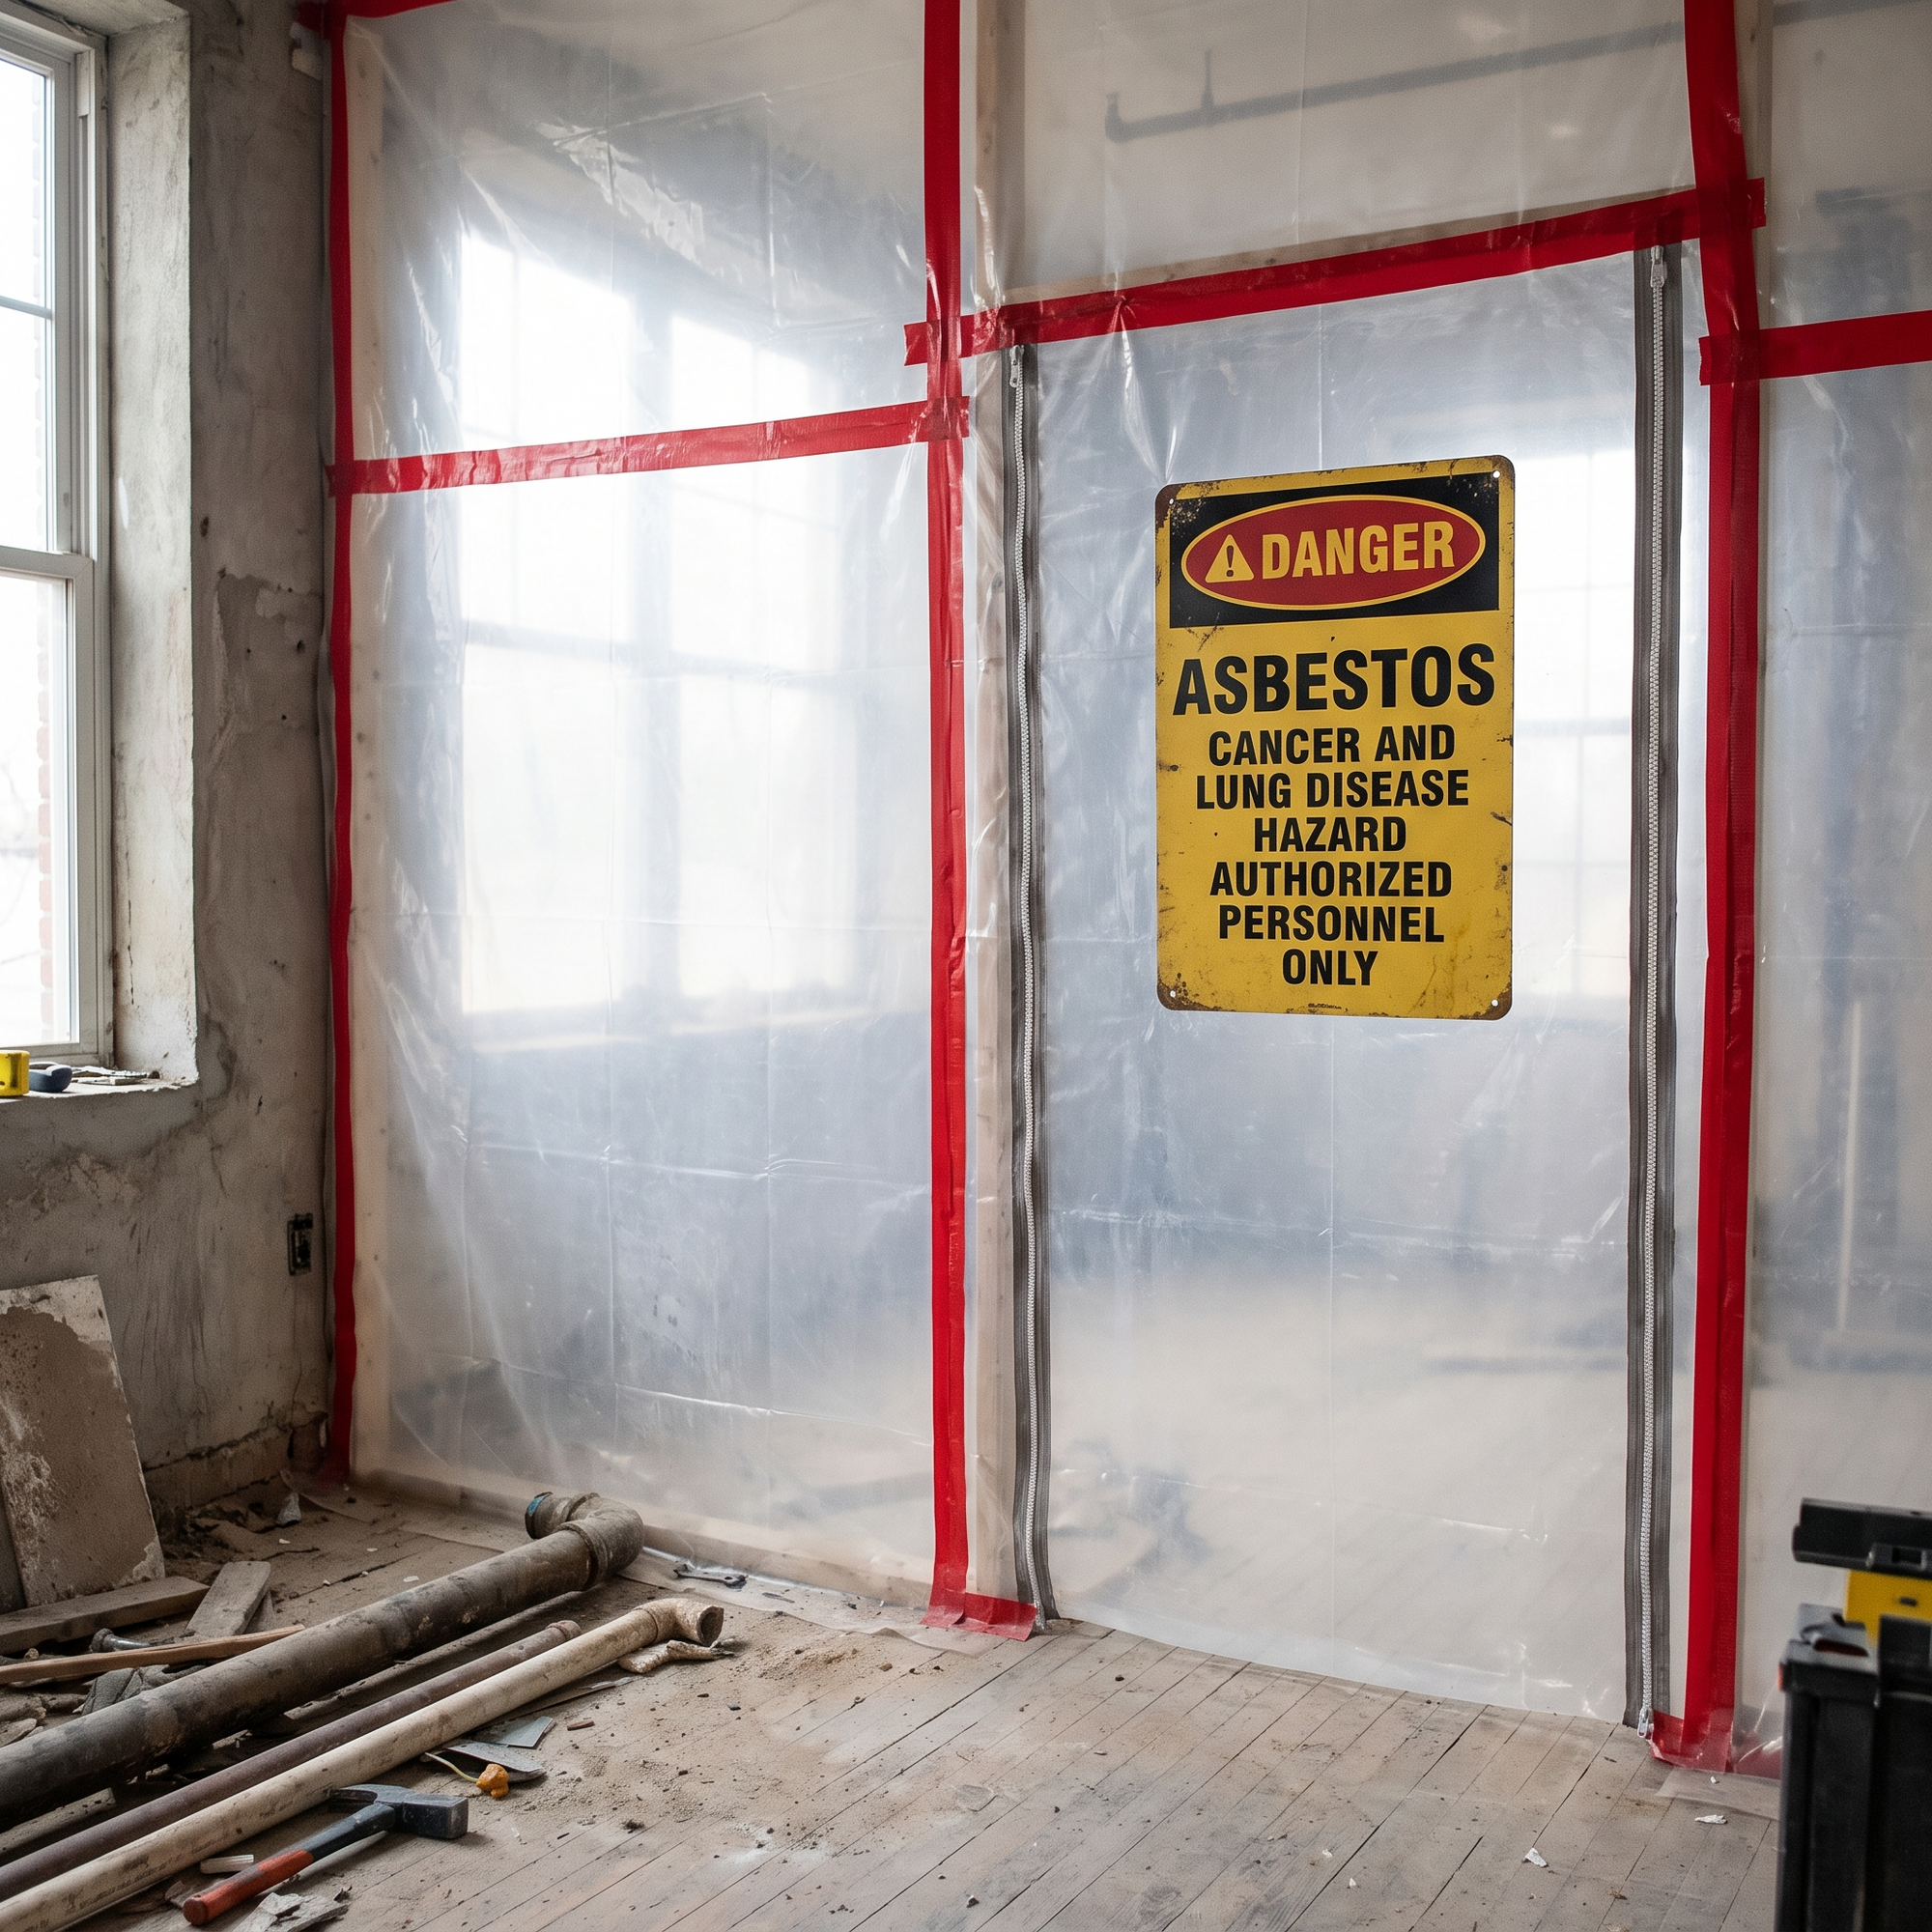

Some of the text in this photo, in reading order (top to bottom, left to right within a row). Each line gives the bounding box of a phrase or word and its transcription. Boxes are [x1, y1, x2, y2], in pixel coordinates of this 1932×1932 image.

[1261, 520, 1456, 581] DANGER
[1172, 642, 1495, 716] ASBESTOS
[1208, 724, 1457, 767] CANCER AND
[1196, 769, 1469, 810] LUNG DISEASE
[1254, 816, 1406, 853] HAZARD
[1209, 860, 1452, 897] AUTHORIZED
[1219, 904, 1445, 943] PERSONNEL
[1282, 948, 1378, 986] ONLY
